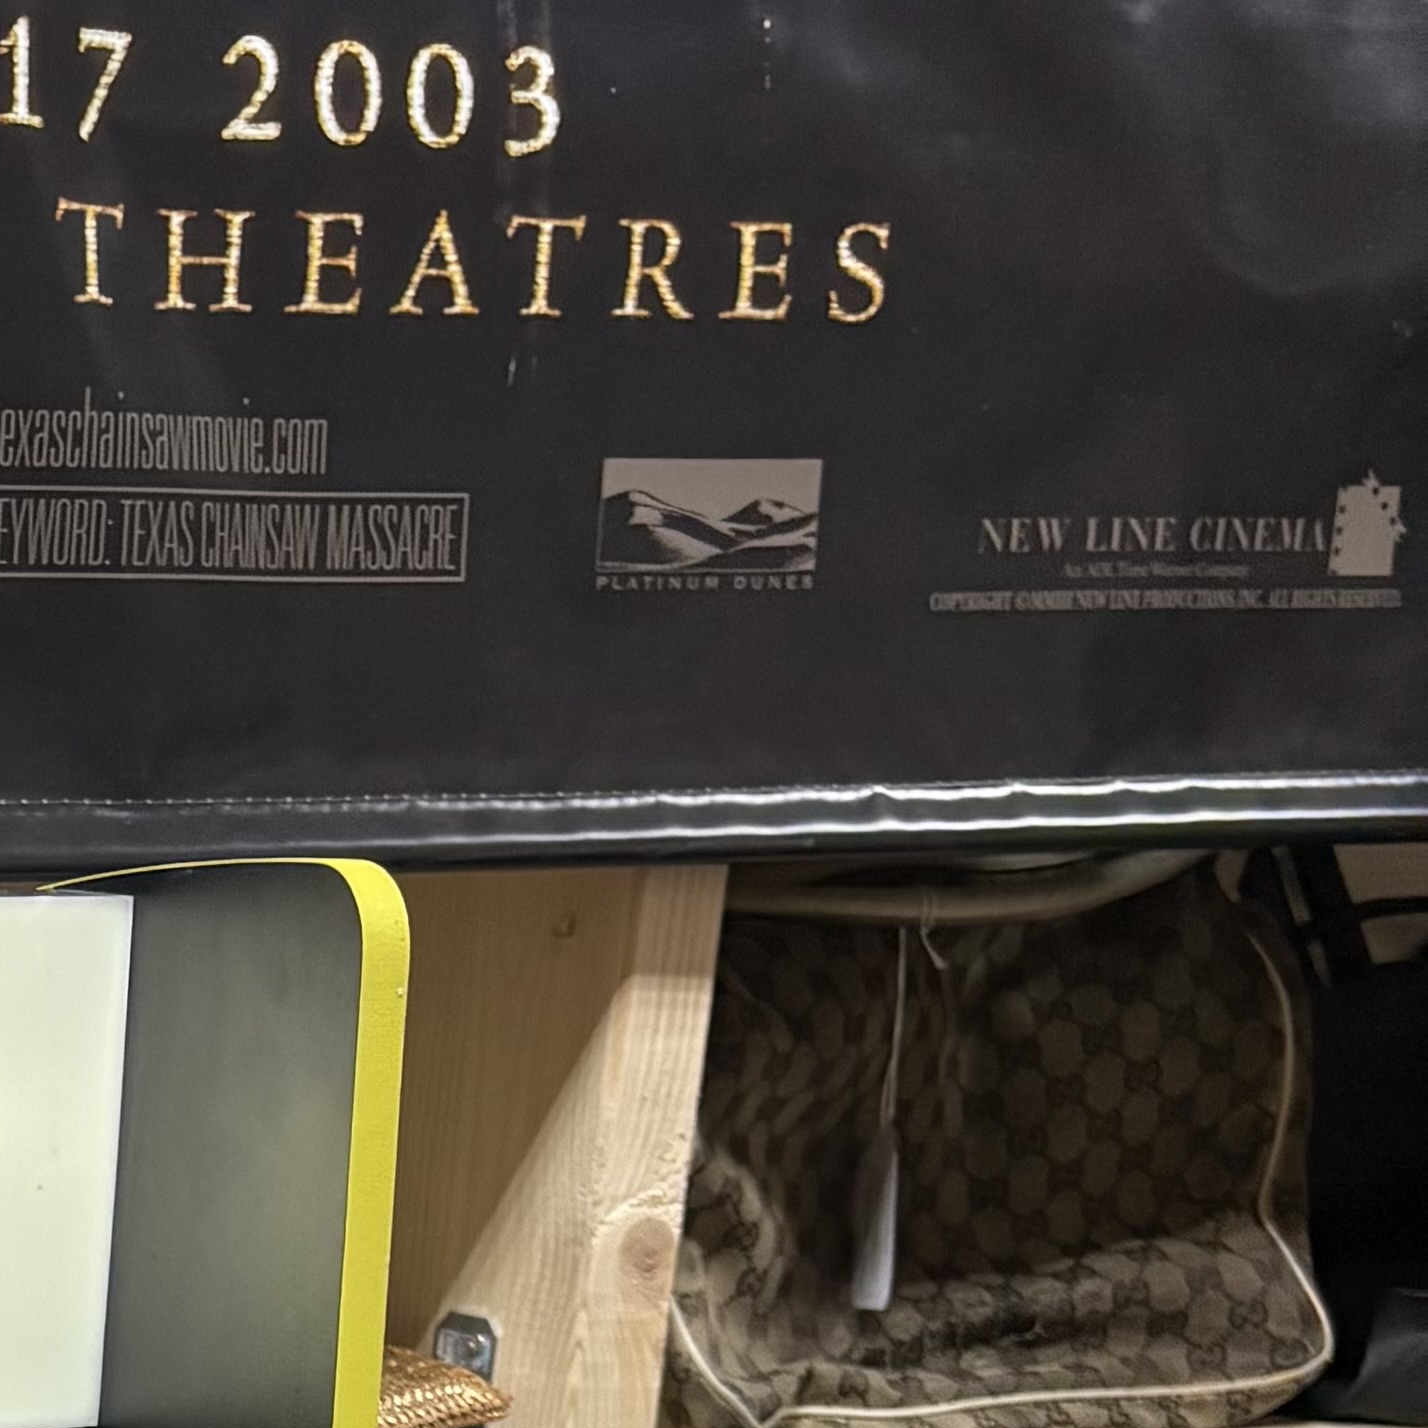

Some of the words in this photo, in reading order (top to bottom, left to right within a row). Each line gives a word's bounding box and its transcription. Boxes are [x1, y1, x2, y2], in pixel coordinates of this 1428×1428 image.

[219, 34, 562, 158] 2003
[54, 196, 891, 325] THEATRES
[119, 500, 194, 569] TEXAS
[200, 501, 319, 571] CHAINSAW
[325, 503, 458, 572] MASSACRE
[978, 516, 1071, 555] NEW
[1085, 516, 1178, 554] LINE
[1188, 516, 1326, 553] CINEMA
[595, 574, 719, 593] PLATINUM
[731, 573, 815, 592] DUNES
